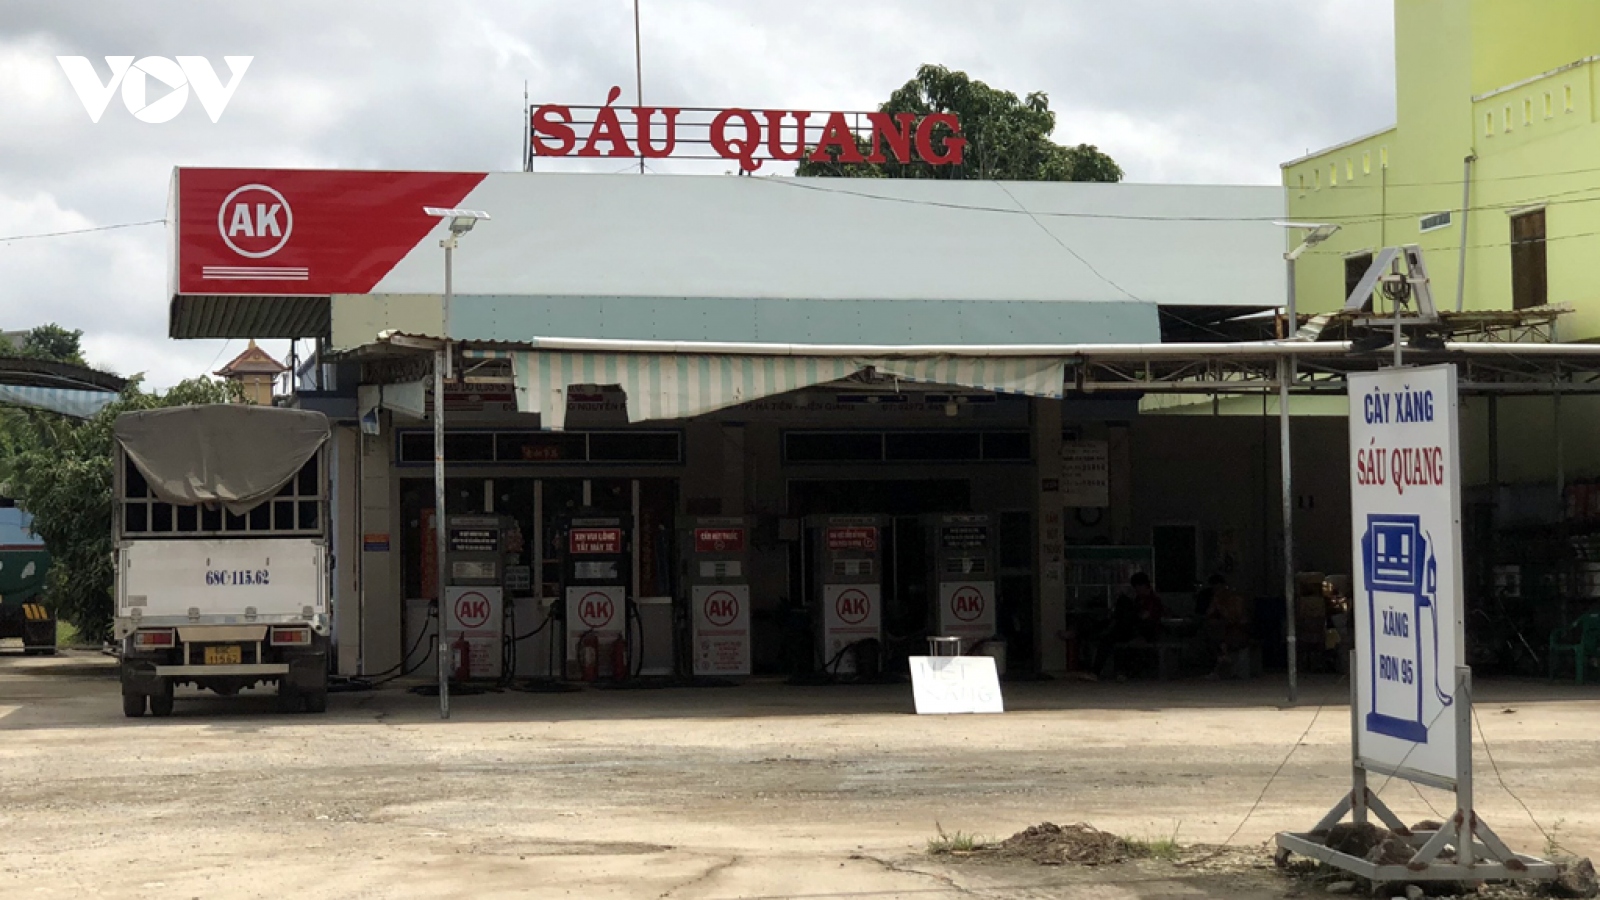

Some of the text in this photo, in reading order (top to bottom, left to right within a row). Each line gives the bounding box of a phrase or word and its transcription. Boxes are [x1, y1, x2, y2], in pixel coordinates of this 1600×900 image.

[532, 86, 967, 172] SÁU QUANG
[228, 203, 282, 237] AK
[1363, 384, 1434, 424] CÂY XĂNG
[1357, 436, 1444, 495] SÁU QUANG
[460, 601, 486, 618] AK
[584, 601, 610, 618] AK
[708, 599, 734, 617] AK
[841, 598, 865, 615] AK
[956, 595, 980, 612] AK
[1382, 605, 1409, 638] XĂNG
[1379, 654, 1413, 685] RON 95
